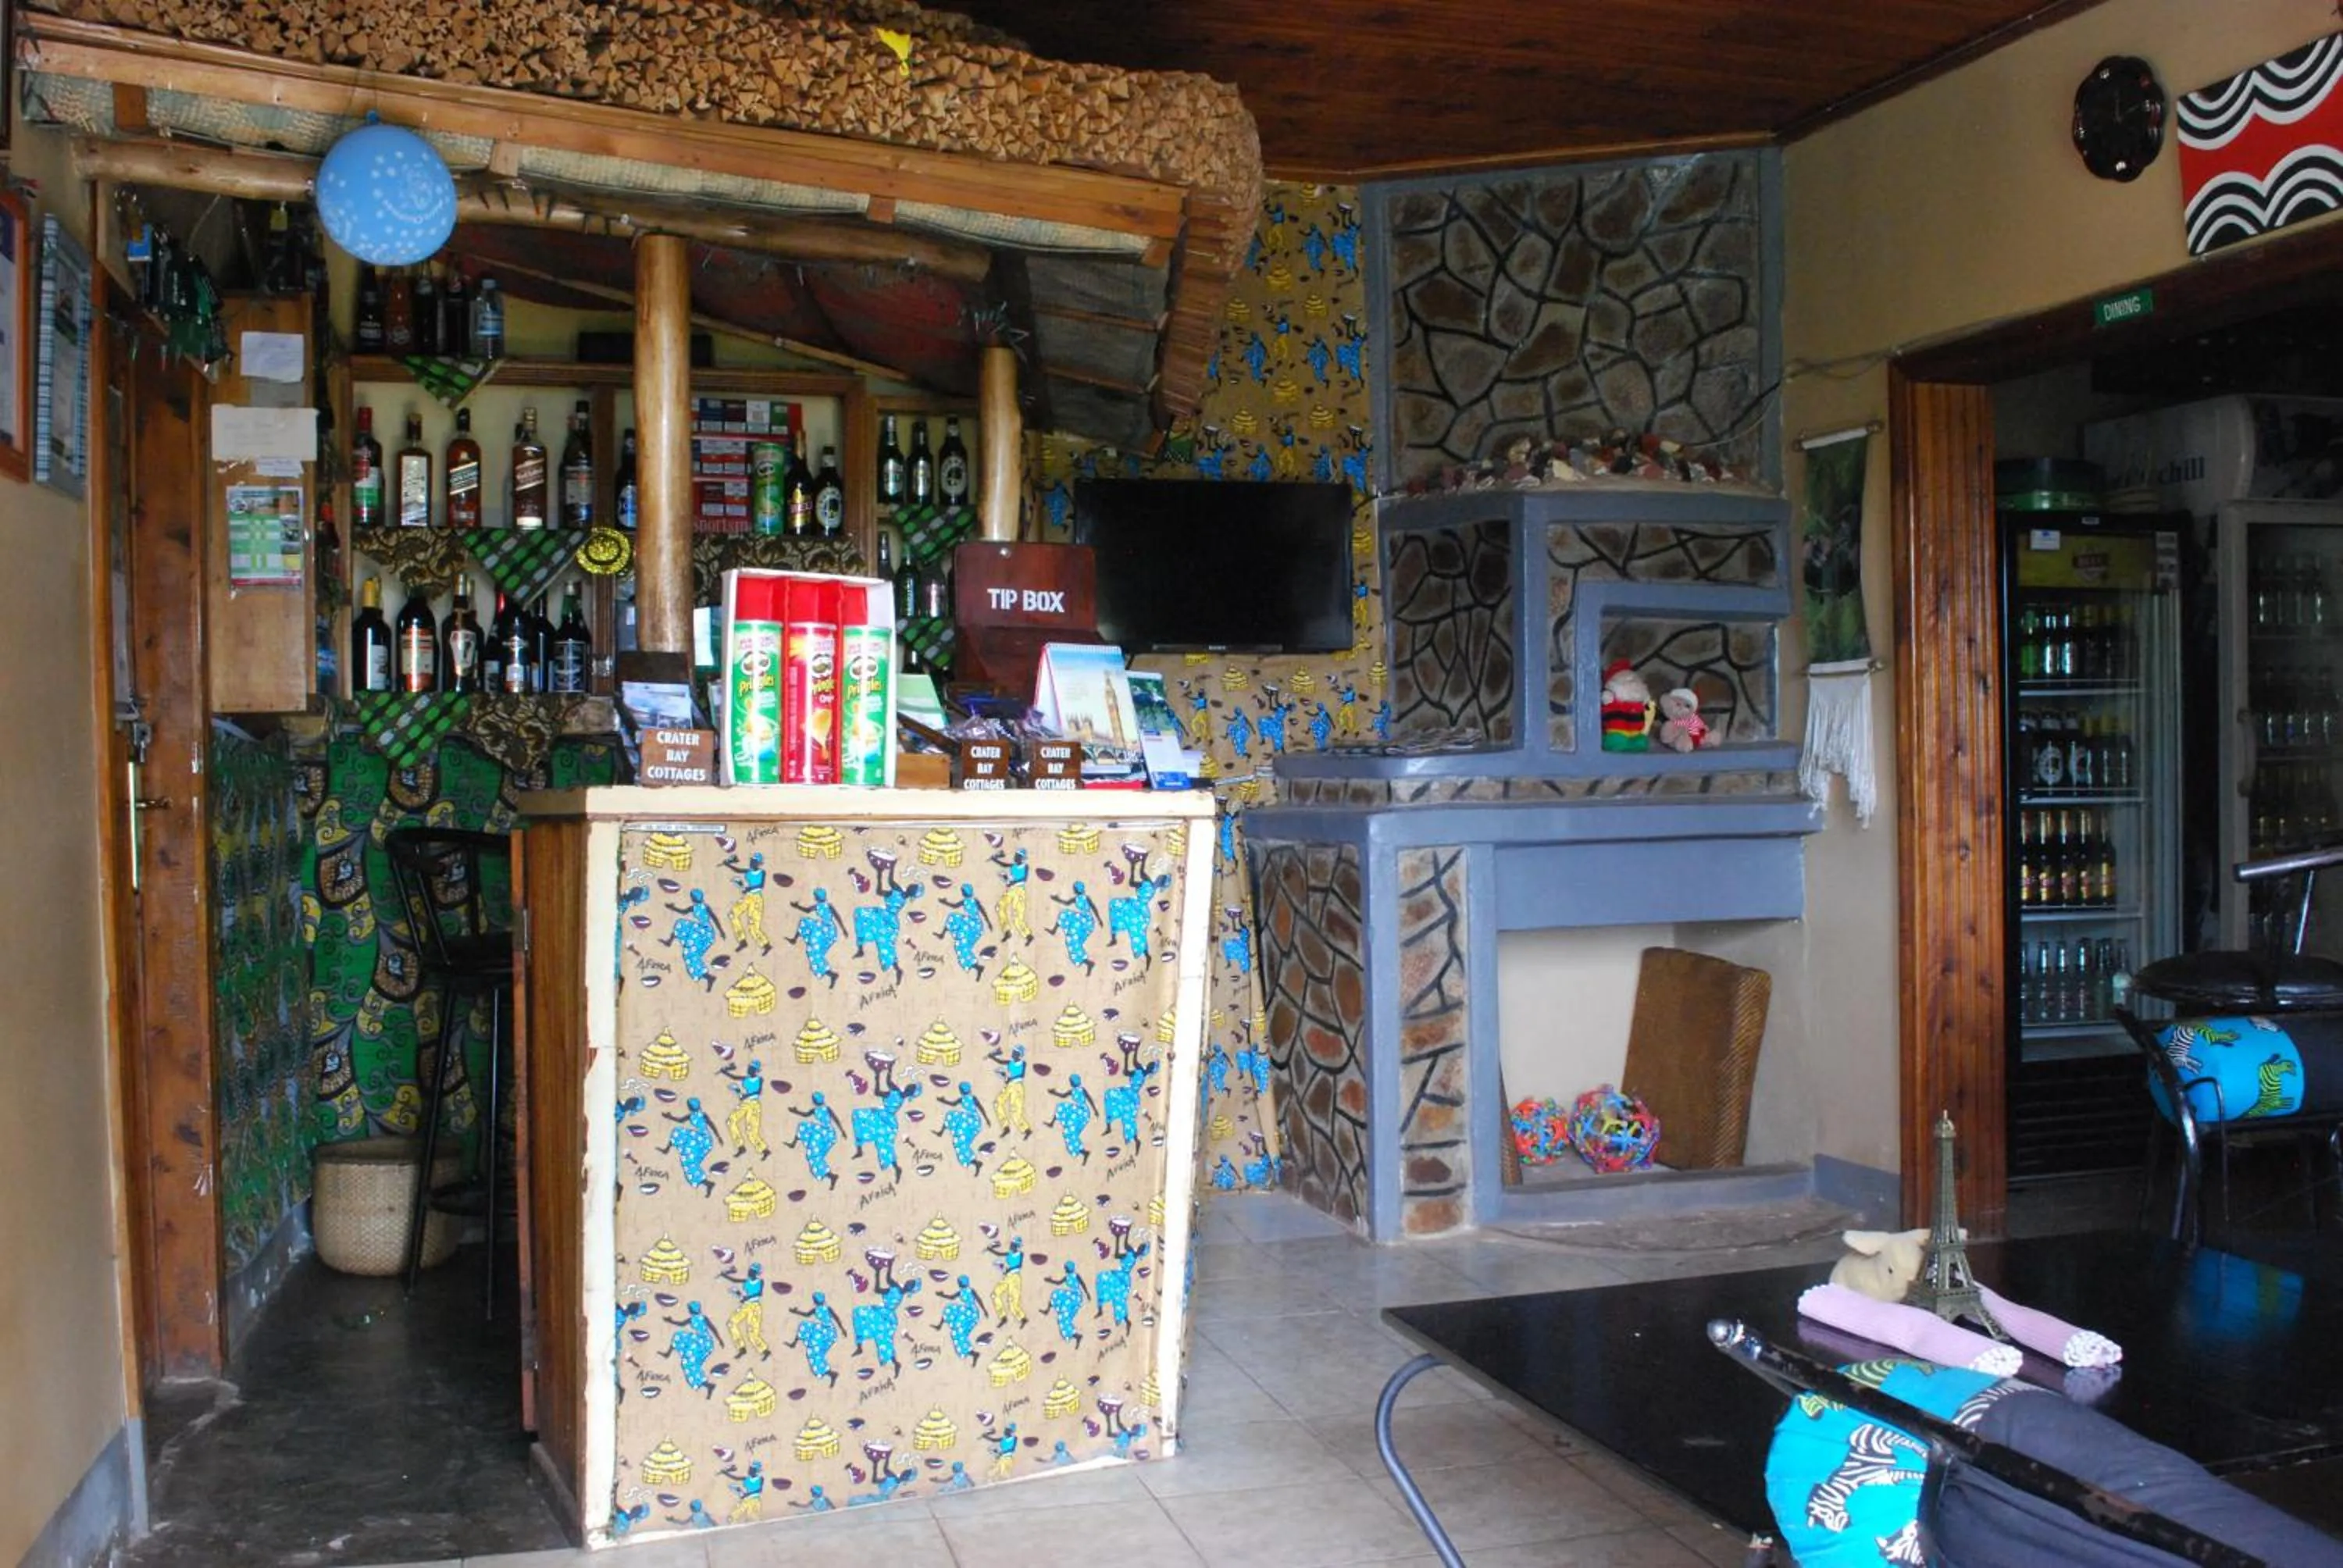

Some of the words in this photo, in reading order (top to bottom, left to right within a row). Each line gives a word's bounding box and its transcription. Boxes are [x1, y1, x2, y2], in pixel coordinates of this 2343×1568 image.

[987, 588, 1018, 610] TIP
[1023, 590, 1065, 613] BOX
[656, 731, 700, 746] CRATER
[665, 749, 689, 762] BAY
[971, 747, 1001, 758] CRATER
[1040, 747, 1071, 758] CRATER
[647, 766, 706, 781] COTTAGES
[977, 763, 994, 774] BAY
[1047, 763, 1064, 774] BAY
[964, 779, 1005, 790] COTTAGES
[1035, 779, 1075, 790] COTTAGES
